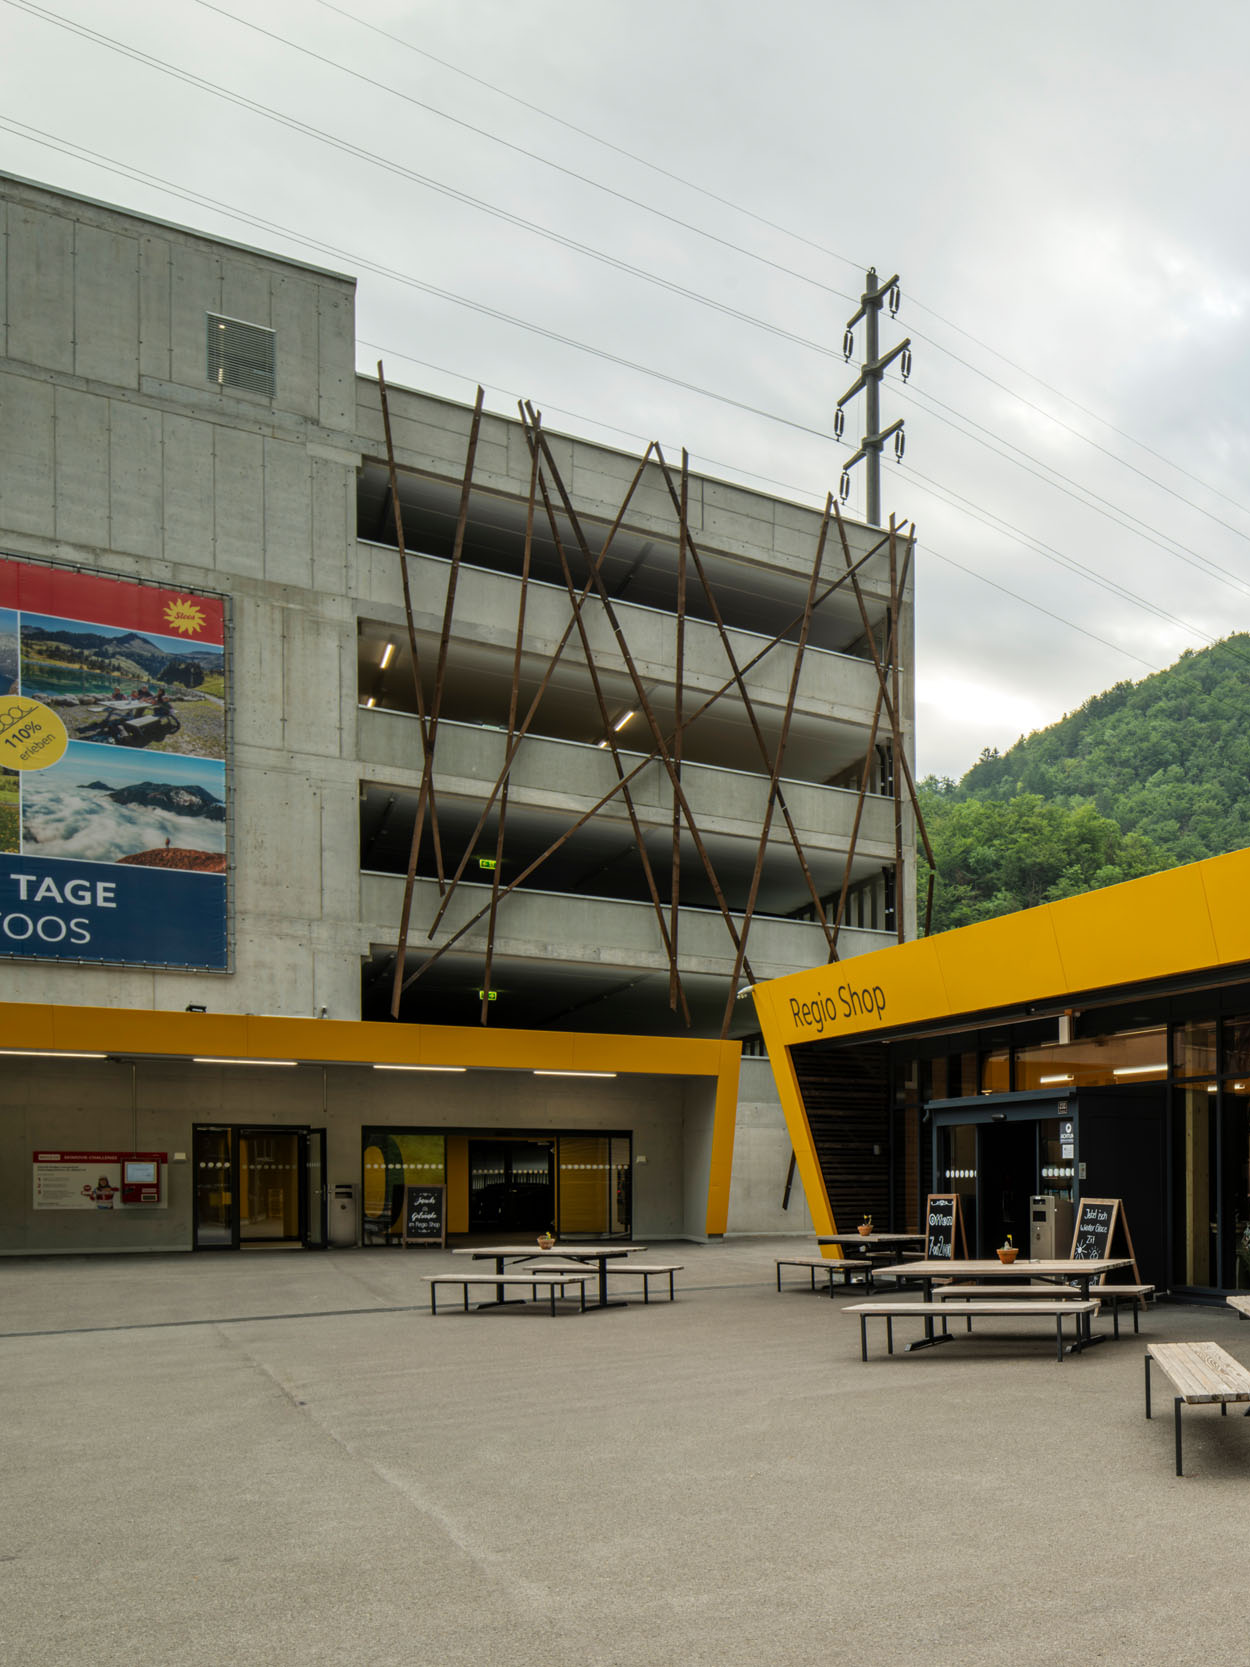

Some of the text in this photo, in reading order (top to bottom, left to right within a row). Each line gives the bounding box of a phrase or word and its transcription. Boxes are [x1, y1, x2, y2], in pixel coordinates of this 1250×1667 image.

[5, 720, 42, 748] 110%
[20, 733, 56, 761] erleben
[10, 873, 117, 908] TAGE
[0, 912, 91, 944] OOS
[789, 983, 886, 1033] Regio Shop
